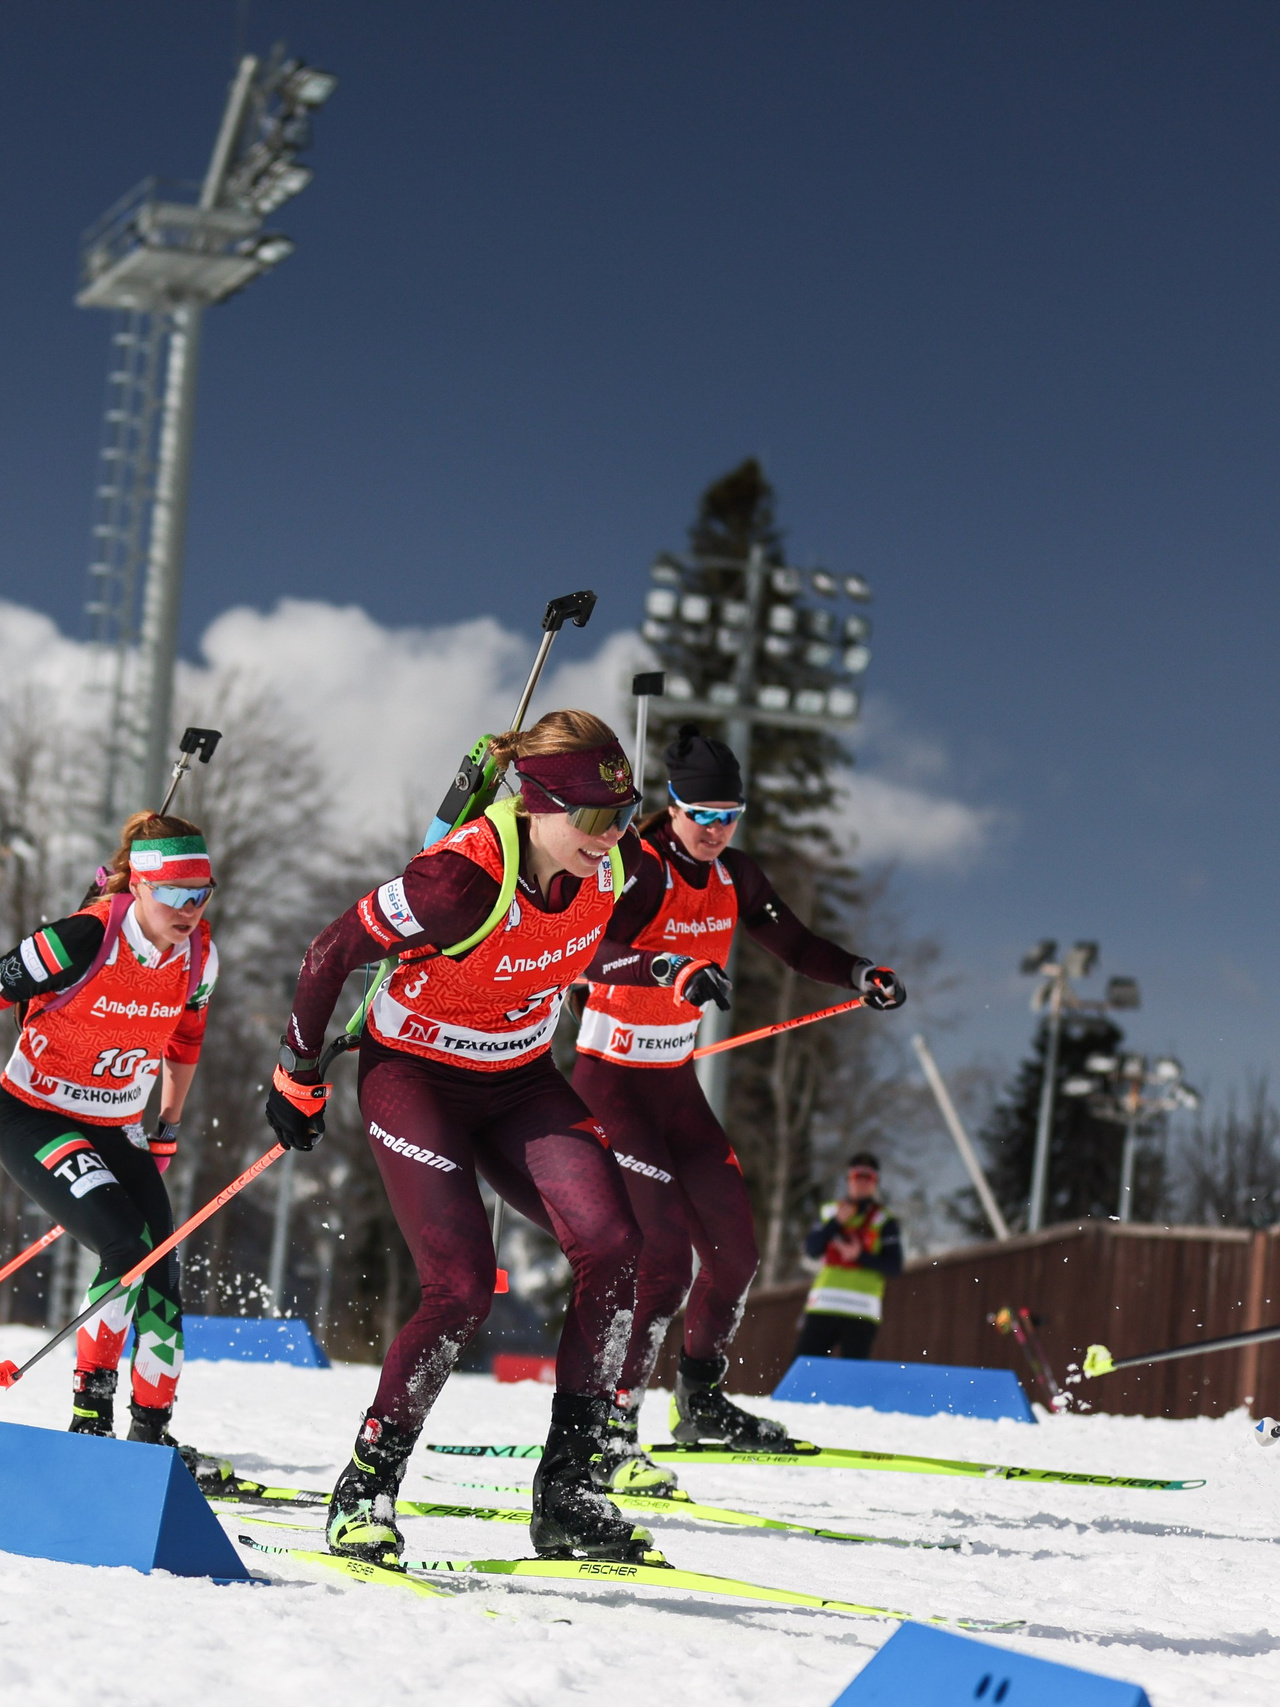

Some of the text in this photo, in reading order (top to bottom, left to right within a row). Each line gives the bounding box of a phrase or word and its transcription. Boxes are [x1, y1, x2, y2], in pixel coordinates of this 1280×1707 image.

[371, 925, 391, 943] Банк
[663, 918, 707, 940] Альфа
[493, 923, 604, 981] Альфа Банк
[404, 970, 429, 999] 3
[90, 995, 148, 1019] Альфа
[91, 1047, 149, 1079] 10
[369, 1120, 459, 1173] proteam
[731, 1455, 799, 1464] FISCHER
[1040, 1471, 1172, 1490] FISCHER
[425, 1504, 532, 1524] FISCHE
[623, 1498, 671, 1510] FISCHER
[346, 1561, 375, 1578] FISCHER
[578, 1563, 638, 1578] FISCHER
